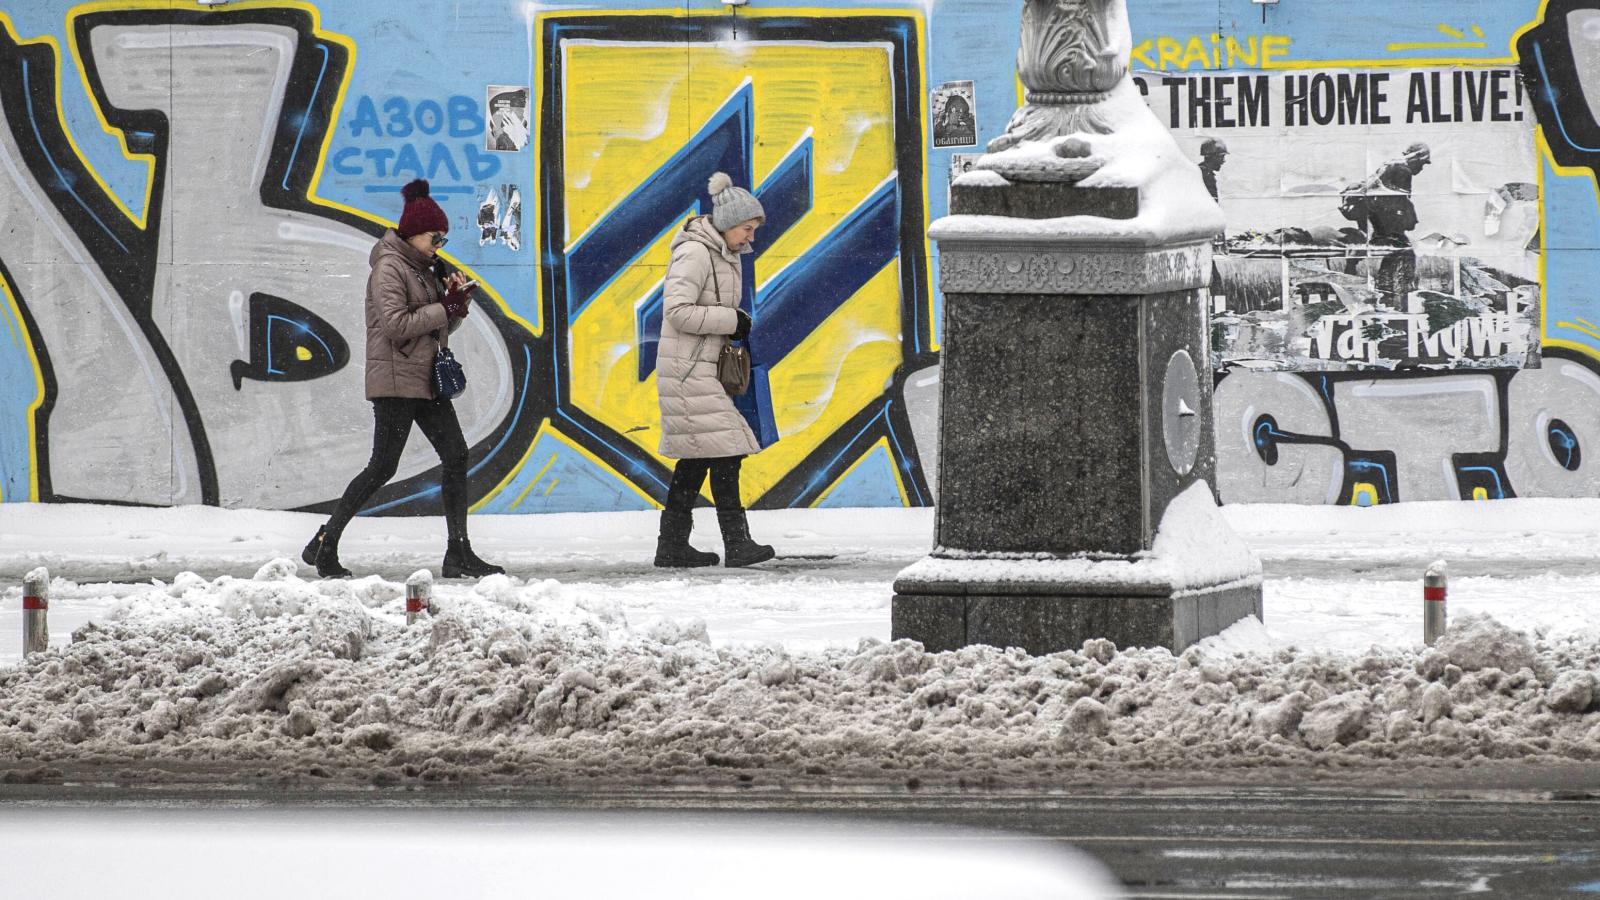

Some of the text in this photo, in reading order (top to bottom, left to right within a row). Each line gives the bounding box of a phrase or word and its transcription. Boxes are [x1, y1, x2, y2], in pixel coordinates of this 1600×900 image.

[1129, 33, 1292, 71] KRAiNE
[349, 95, 485, 138] АЗОВ
[1162, 76, 1271, 129] THEM
[1285, 72, 1391, 126] HOME
[1406, 70, 1524, 124] ALIVE!
[332, 142, 503, 181] СТАЛЬ
